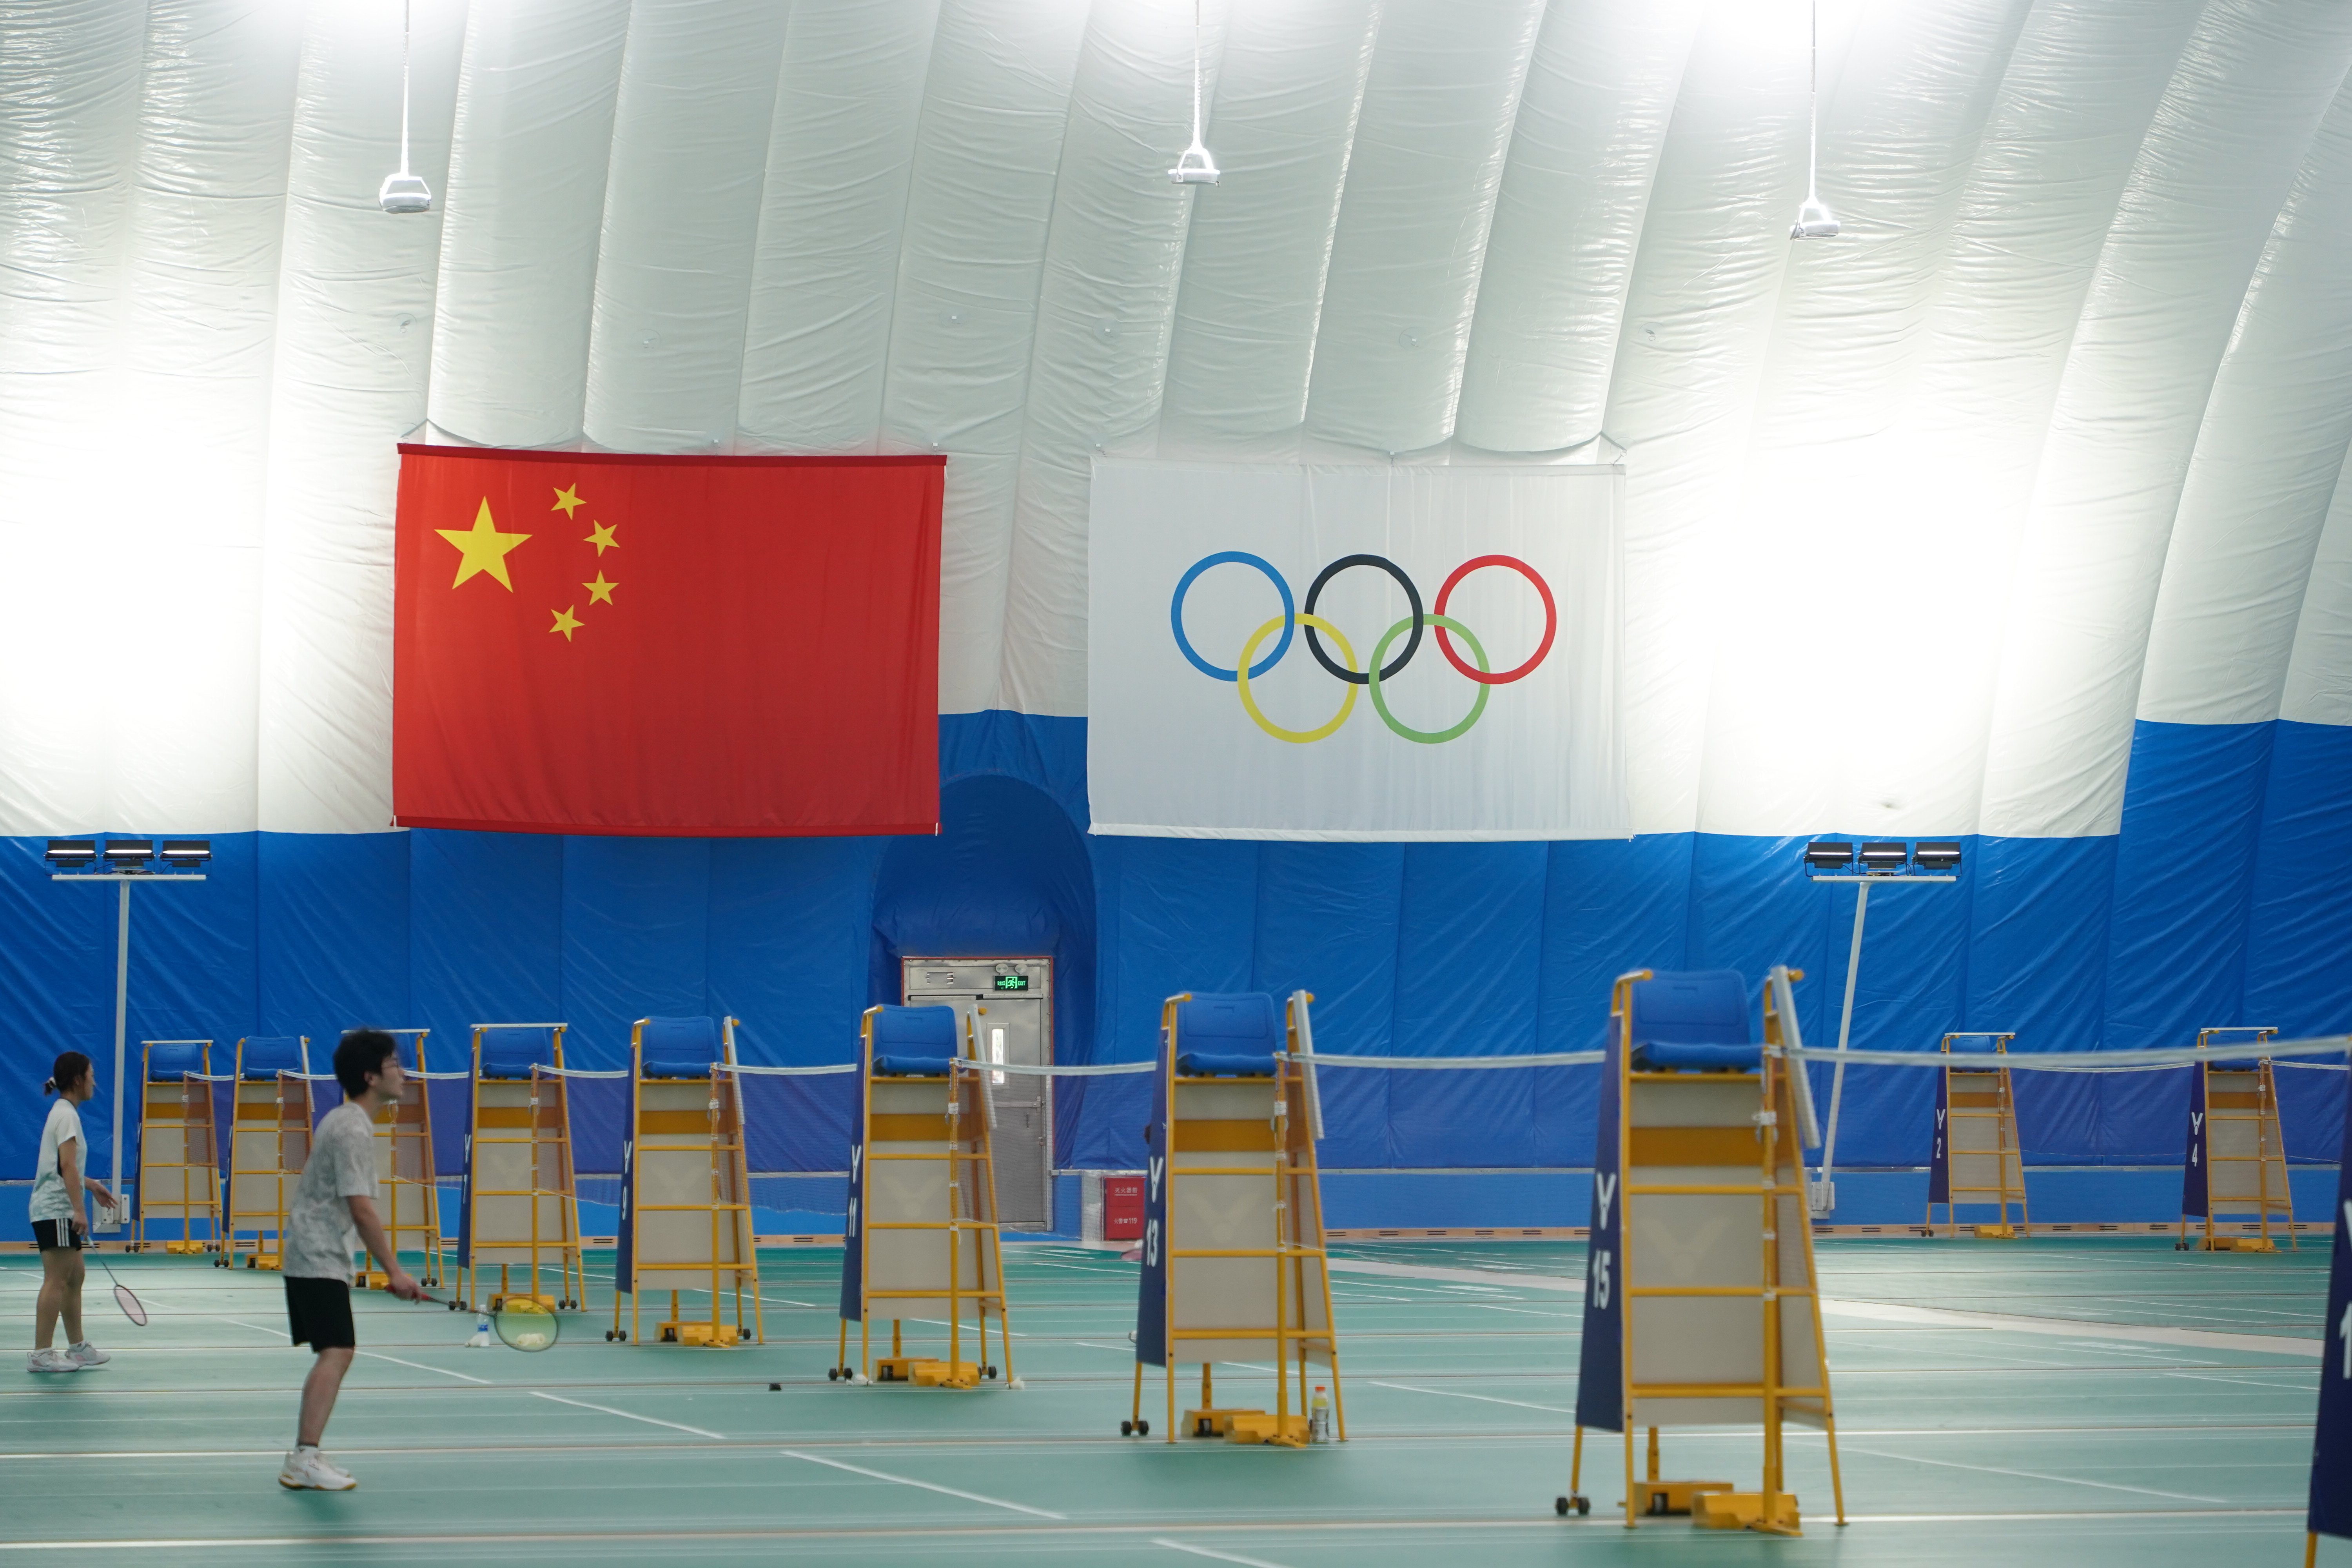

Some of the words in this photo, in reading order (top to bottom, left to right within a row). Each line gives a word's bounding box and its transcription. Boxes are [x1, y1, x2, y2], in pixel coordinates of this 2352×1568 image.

[1936, 1137, 1941, 1159] 2
[2192, 1143, 2198, 1167] 4
[622, 1185, 627, 1221] 9
[848, 1197, 857, 1238] 11
[1147, 1219, 1159, 1268] 13
[1592, 1248, 1611, 1310] 15
